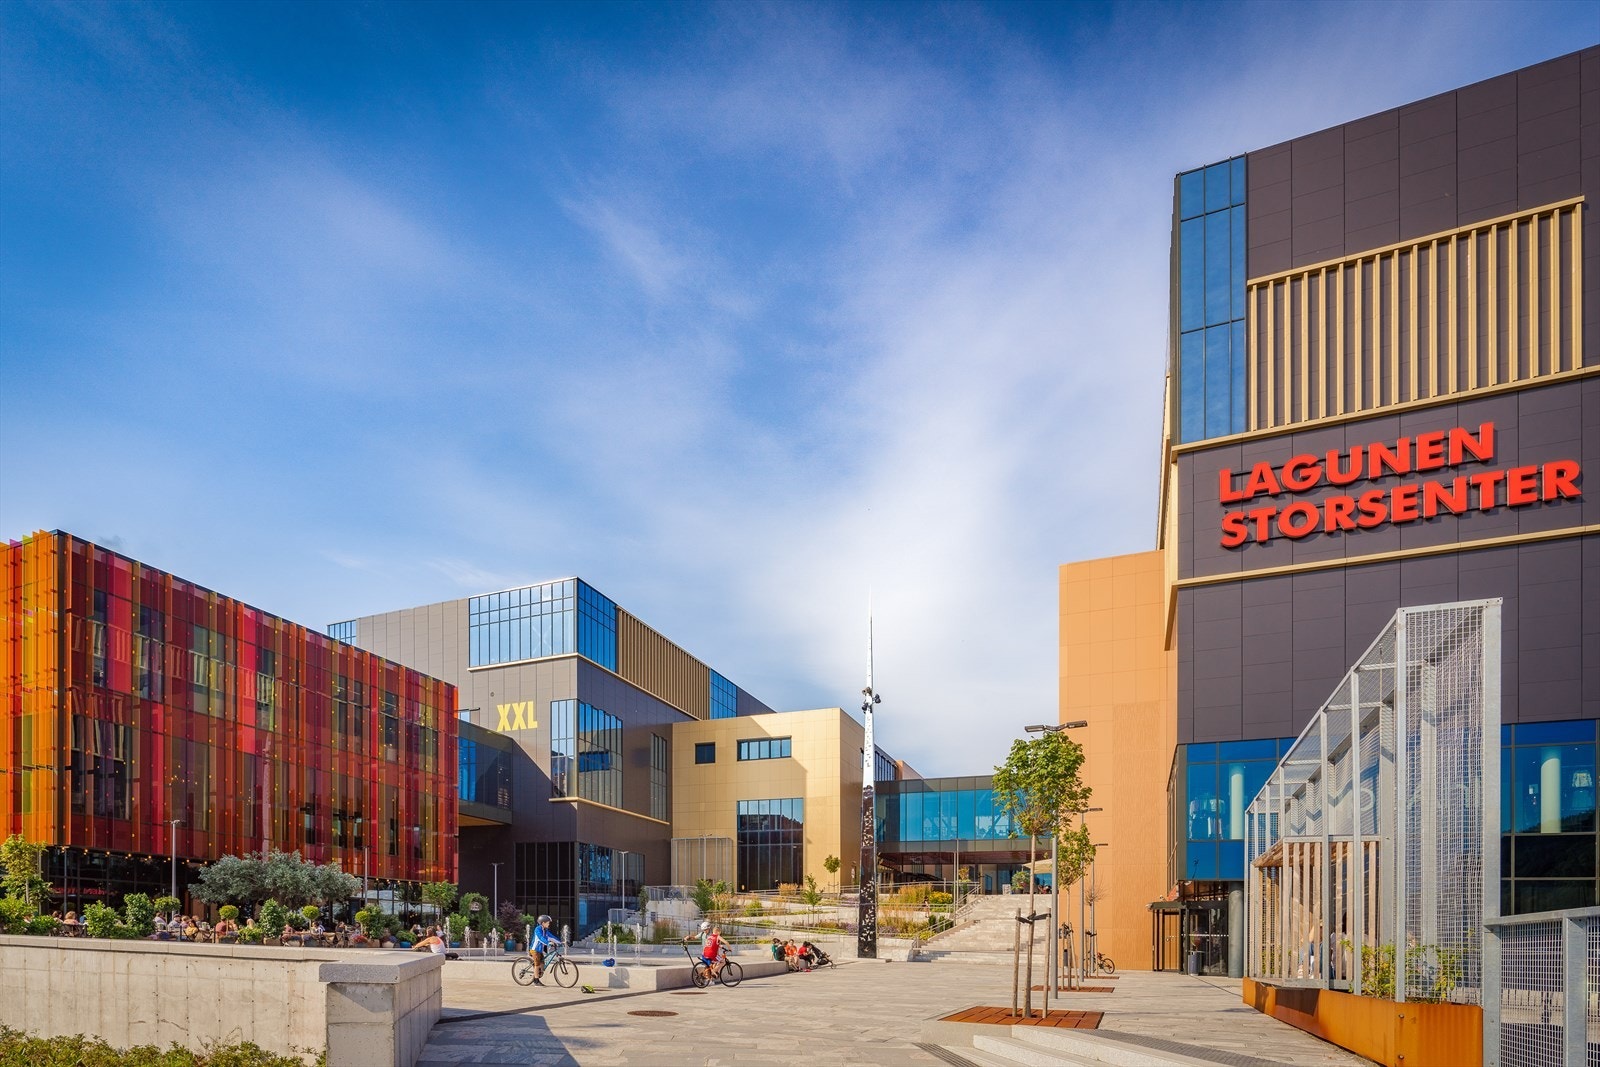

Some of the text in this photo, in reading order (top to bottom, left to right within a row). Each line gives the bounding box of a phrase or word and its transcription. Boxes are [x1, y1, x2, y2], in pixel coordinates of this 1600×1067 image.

[1219, 422, 1494, 504] LAGUNEN
[1220, 459, 1582, 548] STORSENTER
[496, 701, 538, 732] XXL
